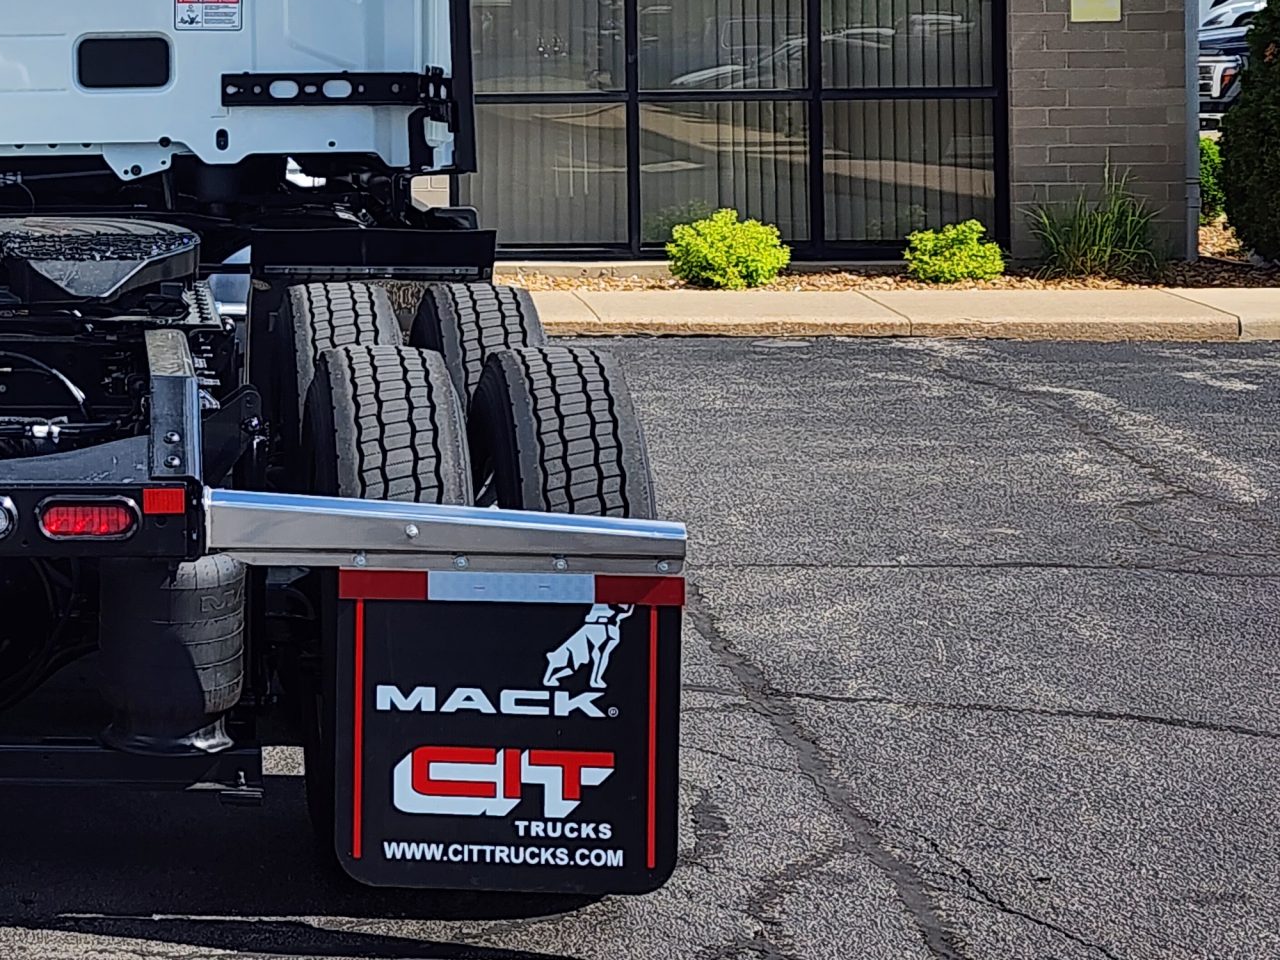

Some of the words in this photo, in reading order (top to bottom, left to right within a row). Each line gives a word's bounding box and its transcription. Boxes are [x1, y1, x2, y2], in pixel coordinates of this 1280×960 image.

[393, 746, 615, 818] CIT
[515, 821, 612, 839] TRUCKS
[384, 842, 624, 867] WWW.CITTRUCKS.COM
